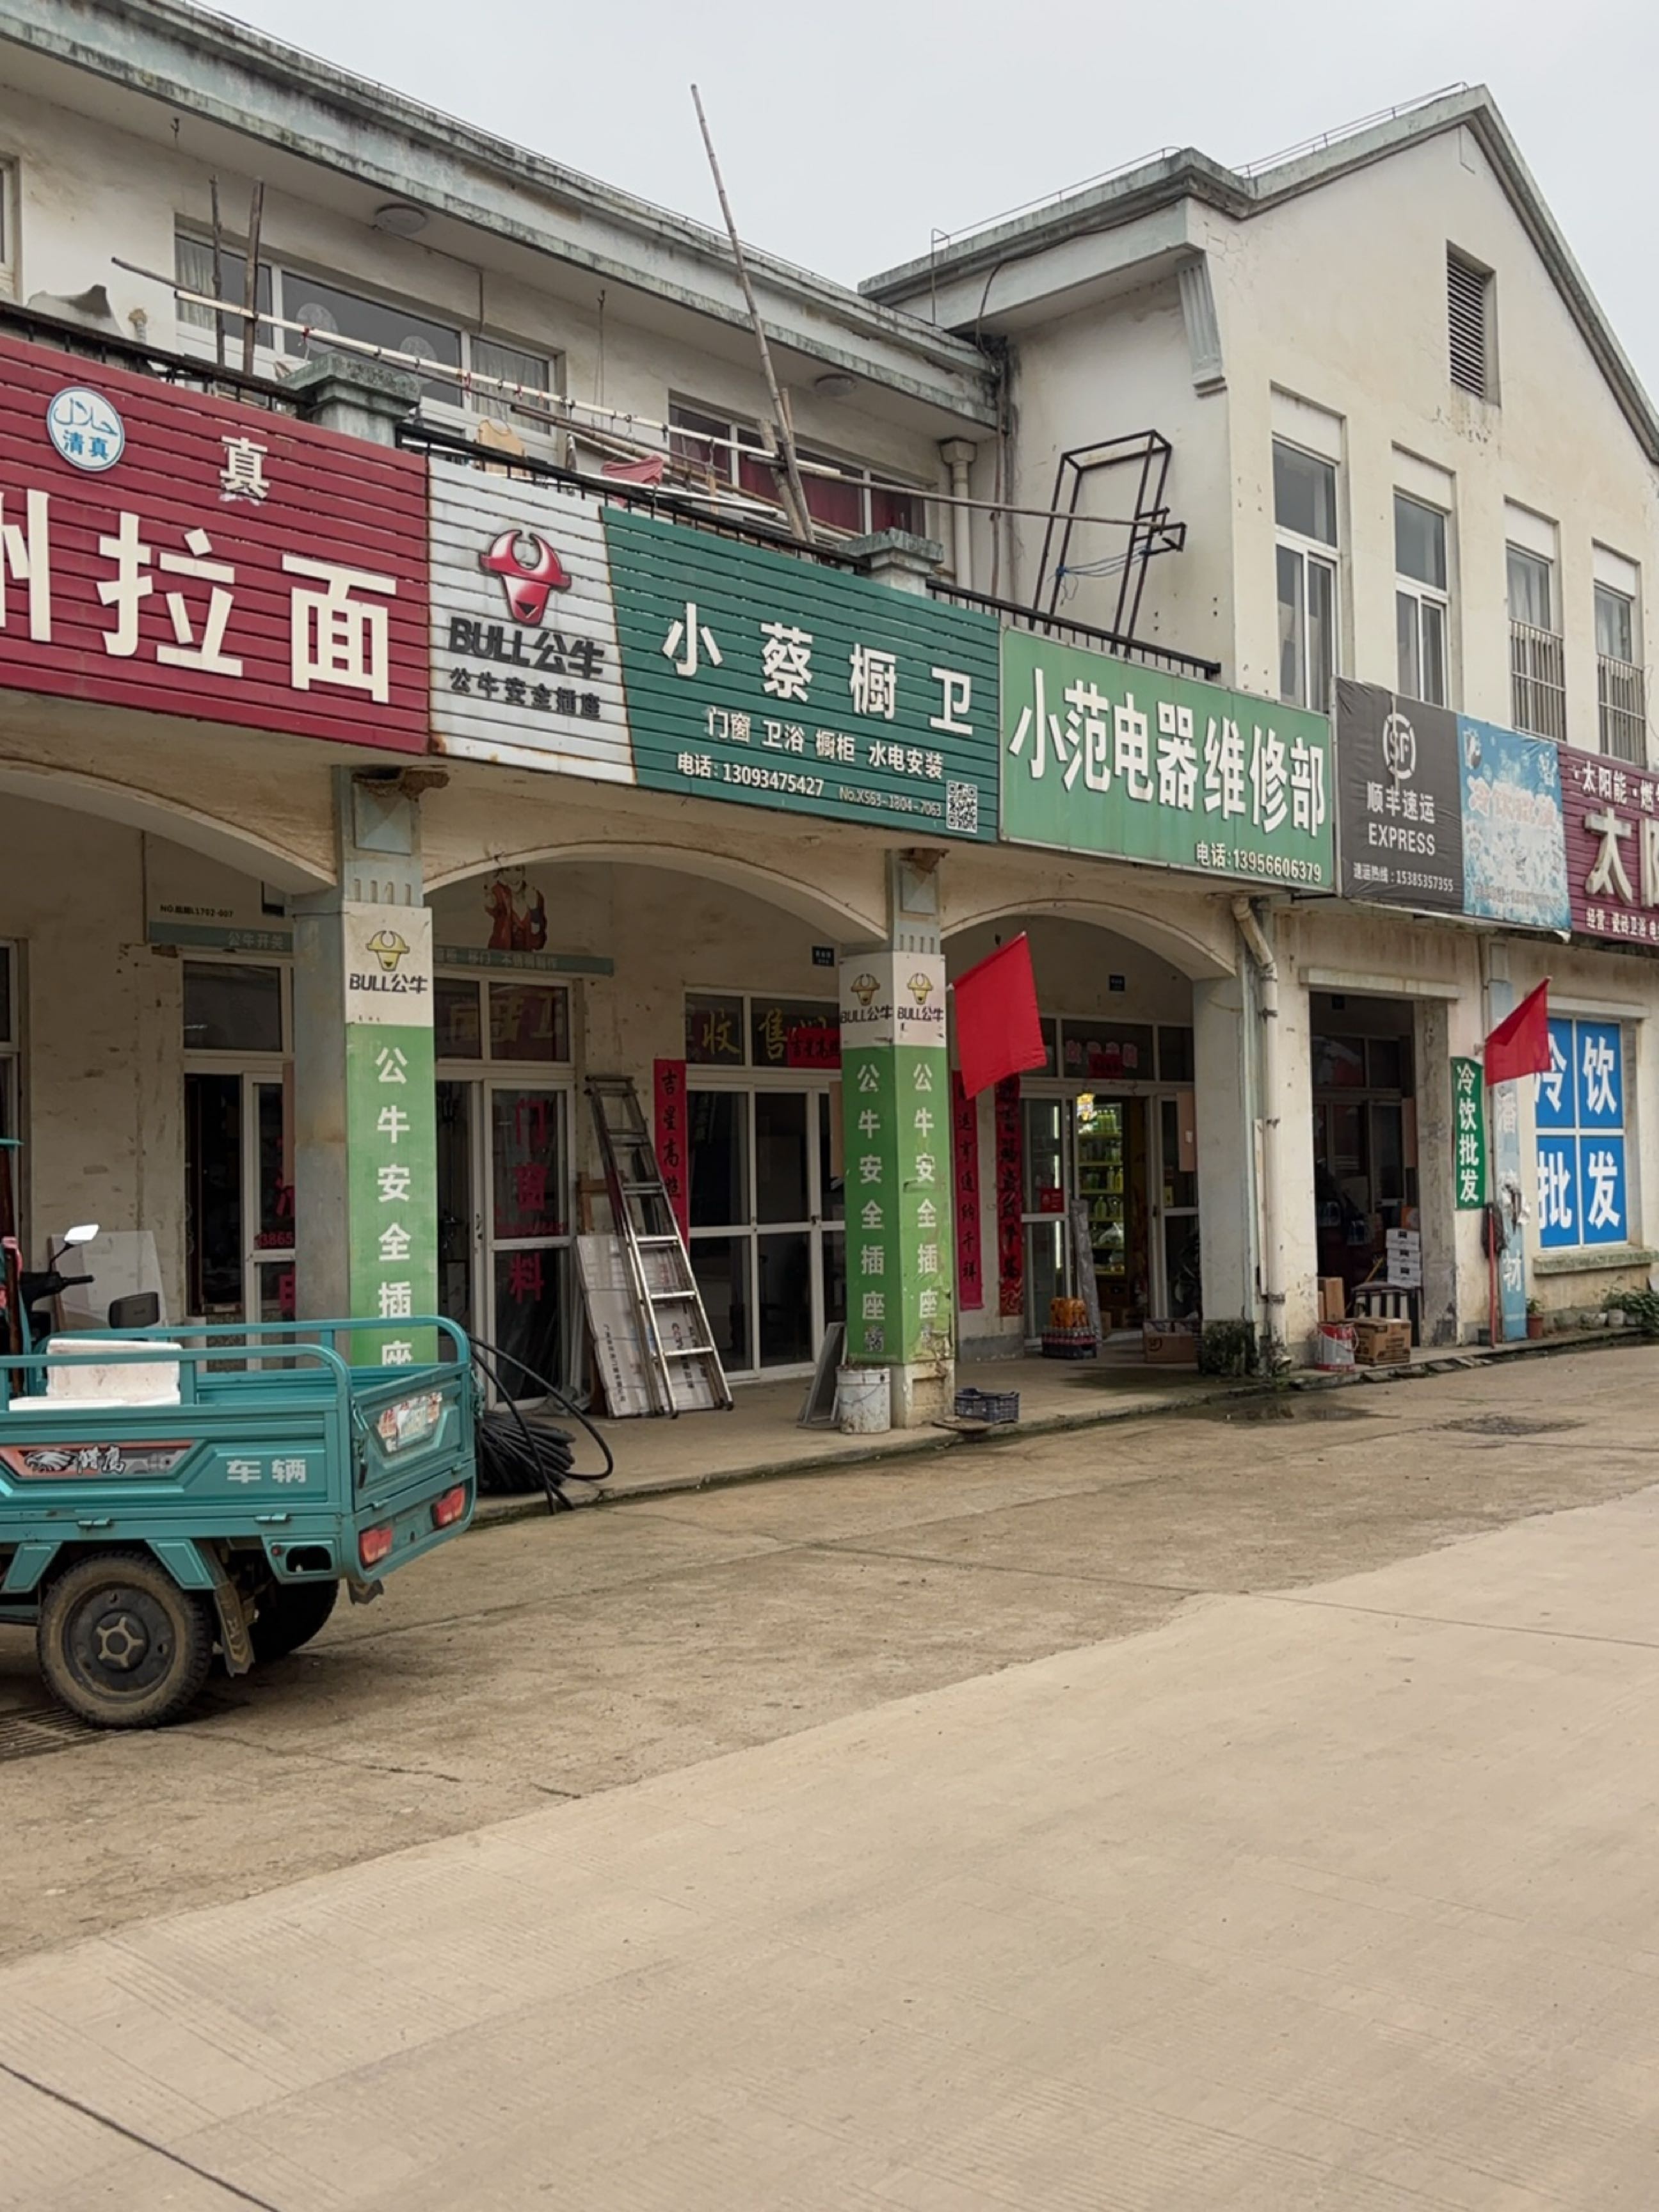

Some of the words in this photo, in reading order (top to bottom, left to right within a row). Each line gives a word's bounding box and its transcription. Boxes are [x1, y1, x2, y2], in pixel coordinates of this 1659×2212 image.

[63, 429, 108, 460] 清真
[220, 435, 269, 499] 真
[450, 668, 600, 719] 公牛安全插座
[662, 602, 973, 735] 小蔡橱卫
[707, 707, 751, 743] 门窗
[762, 719, 805, 754] 卫浴
[815, 728, 856, 763] 橱柜
[868, 740, 943, 780] 水电安装
[1009, 668, 1325, 837] 小范电器维修部
[1366, 781, 1436, 825] 顺丰速运
[1368, 822, 1436, 856] EXPRESS
[228, 931, 284, 950] 公牛开关
[349, 973, 428, 994] BULL公牛
[1456, 1062, 1480, 1203] 冷饮批发
[374, 1047, 415, 1365] 公牛安全插座
[857, 1063, 886, 1320] 公牛安全插座
[913, 1062, 938, 1319] 公牛安全插座
[1537, 1150, 1621, 1230] 批发
[226, 1458, 307, 1485] 车辆
